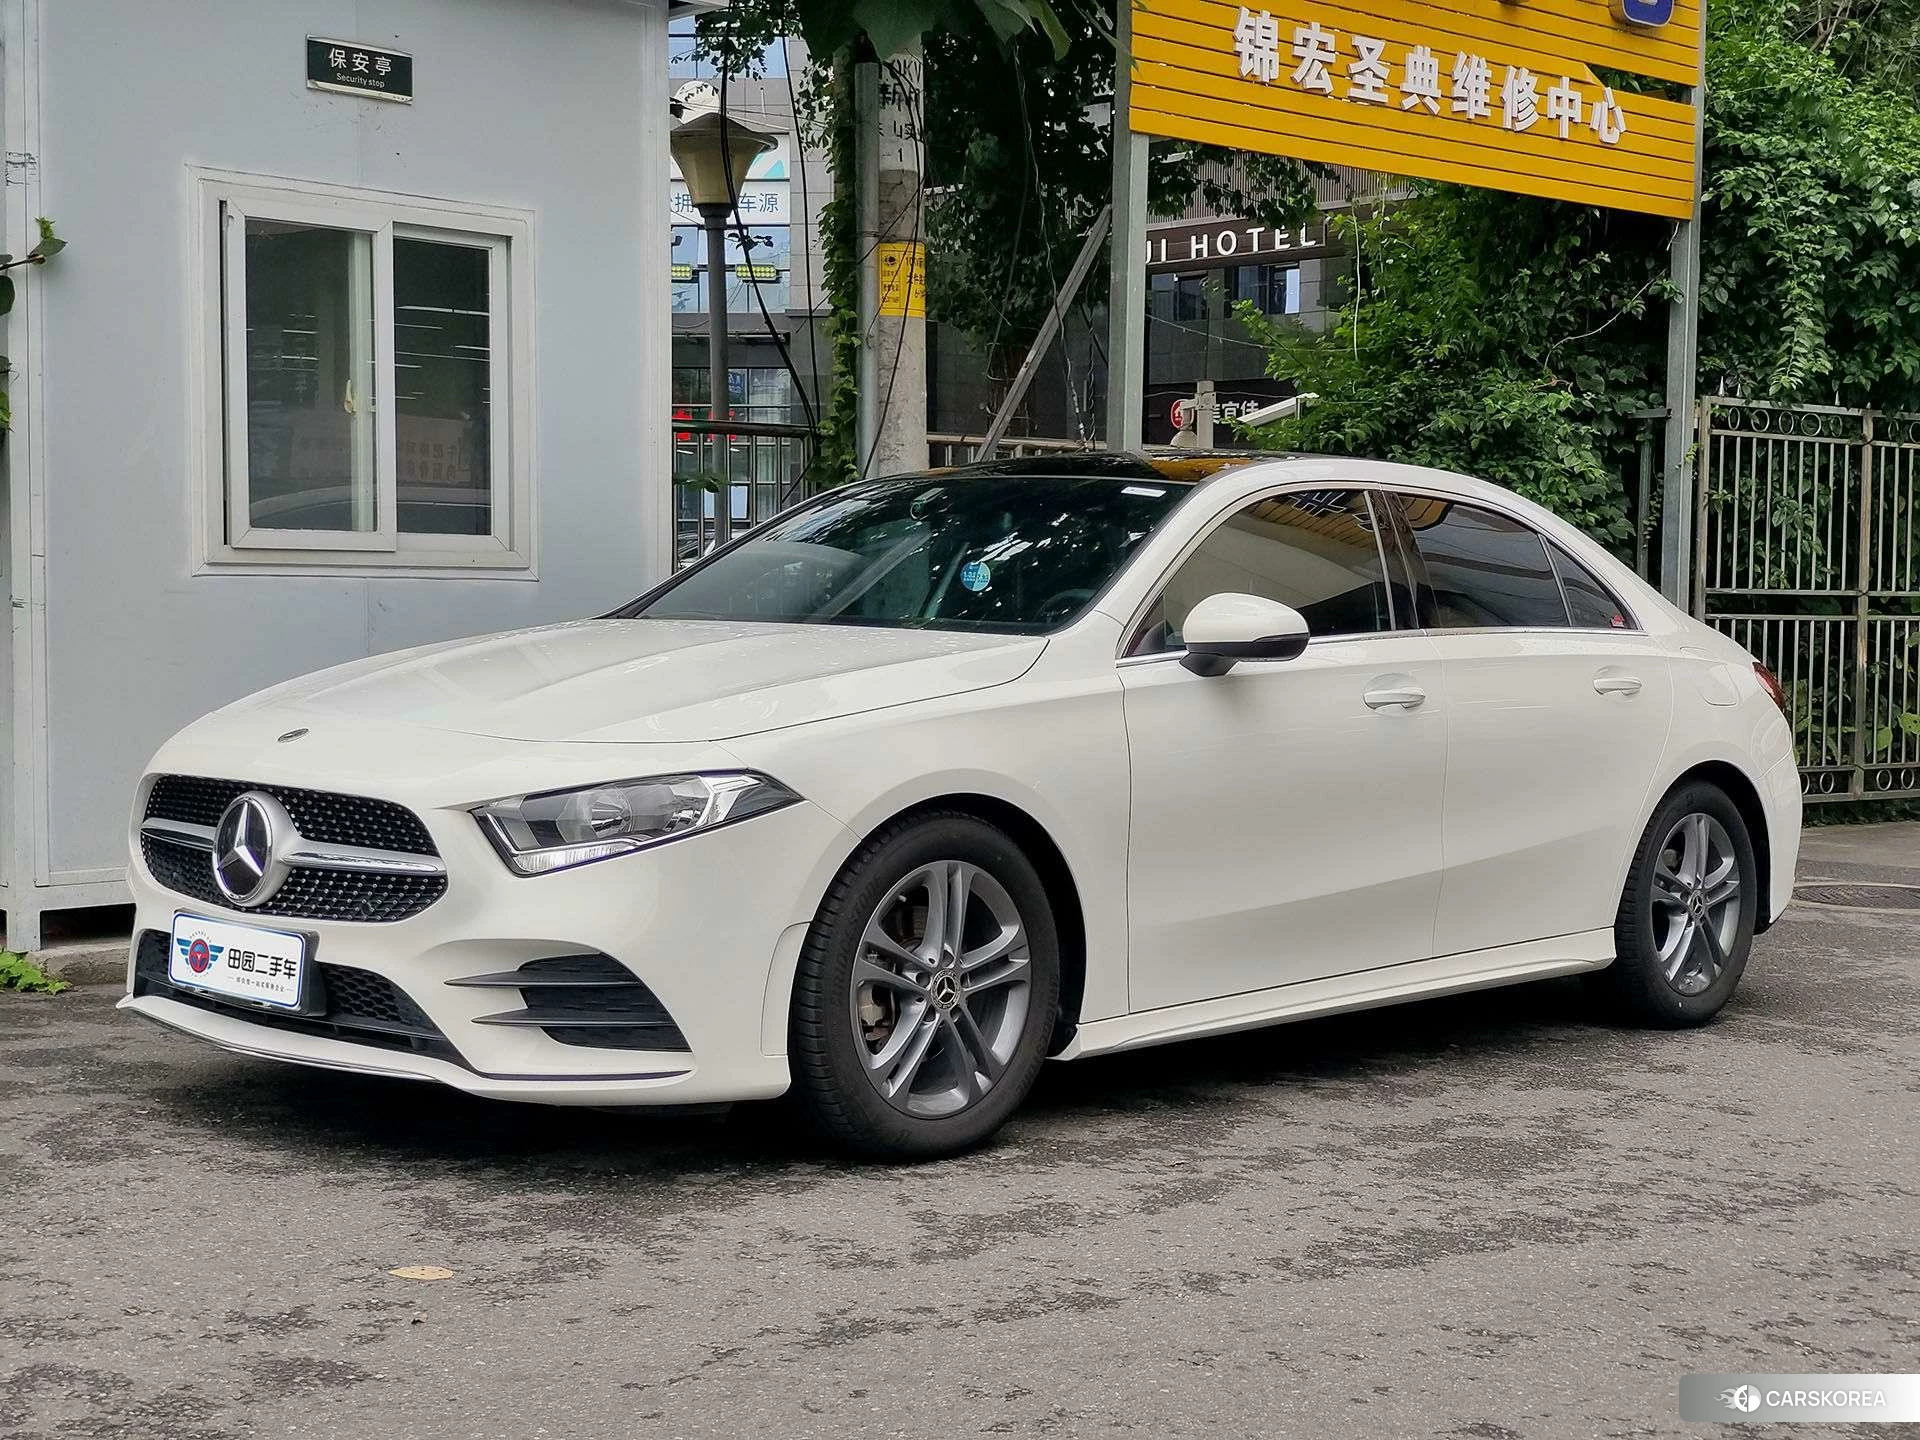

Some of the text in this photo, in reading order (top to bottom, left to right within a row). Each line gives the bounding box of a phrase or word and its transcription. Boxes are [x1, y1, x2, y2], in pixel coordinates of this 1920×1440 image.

[328, 47, 392, 76] 保安亭
[1233, 6, 1627, 144] 锦宏圣典维修中心
[336, 72, 385, 88] Security stop
[1191, 222, 1316, 259] HOTEL
[228, 948, 297, 980] 田园二手车
